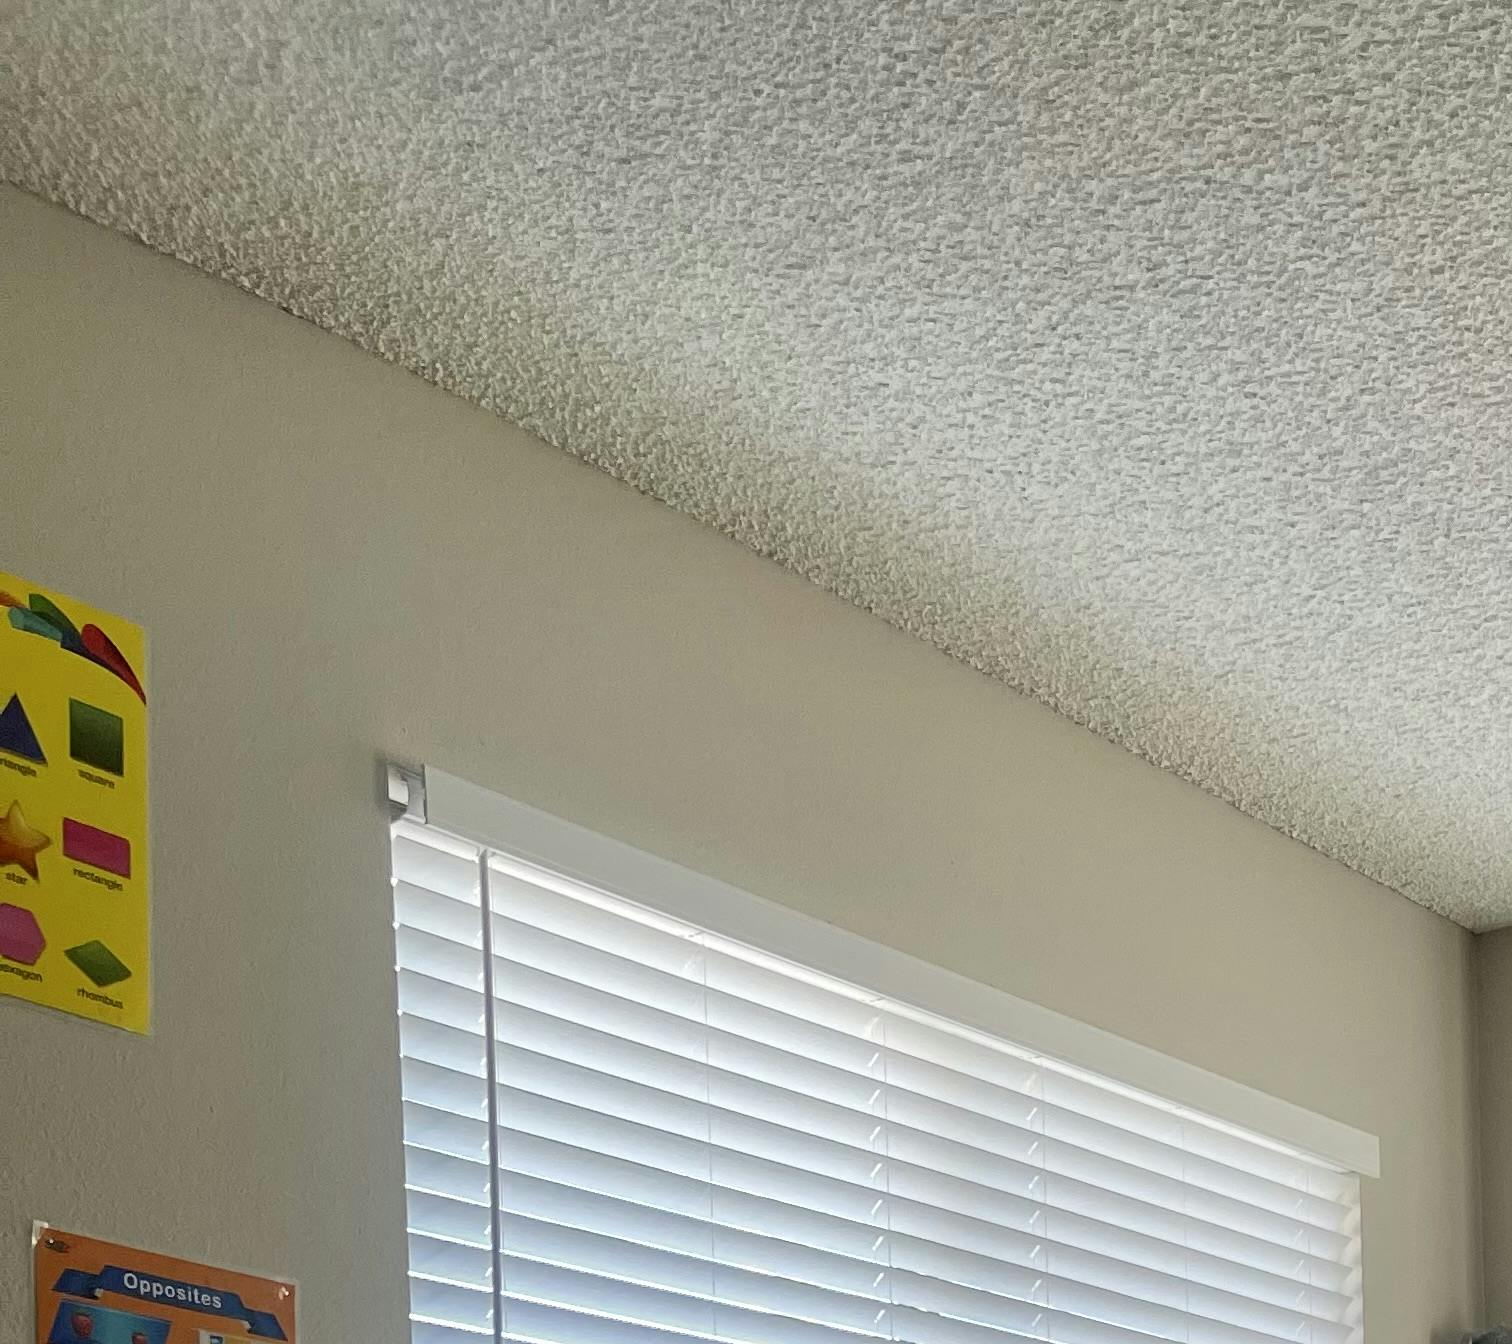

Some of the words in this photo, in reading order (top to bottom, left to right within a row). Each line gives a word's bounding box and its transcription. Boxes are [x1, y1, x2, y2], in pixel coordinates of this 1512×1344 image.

[0, 758, 37, 777] riangle
[6, 872, 28, 885] star
[73, 868, 123, 891] rectangle
[0, 963, 43, 982] exagon
[77, 988, 123, 1009] rhombus
[123, 1272, 222, 1309] Opposites
